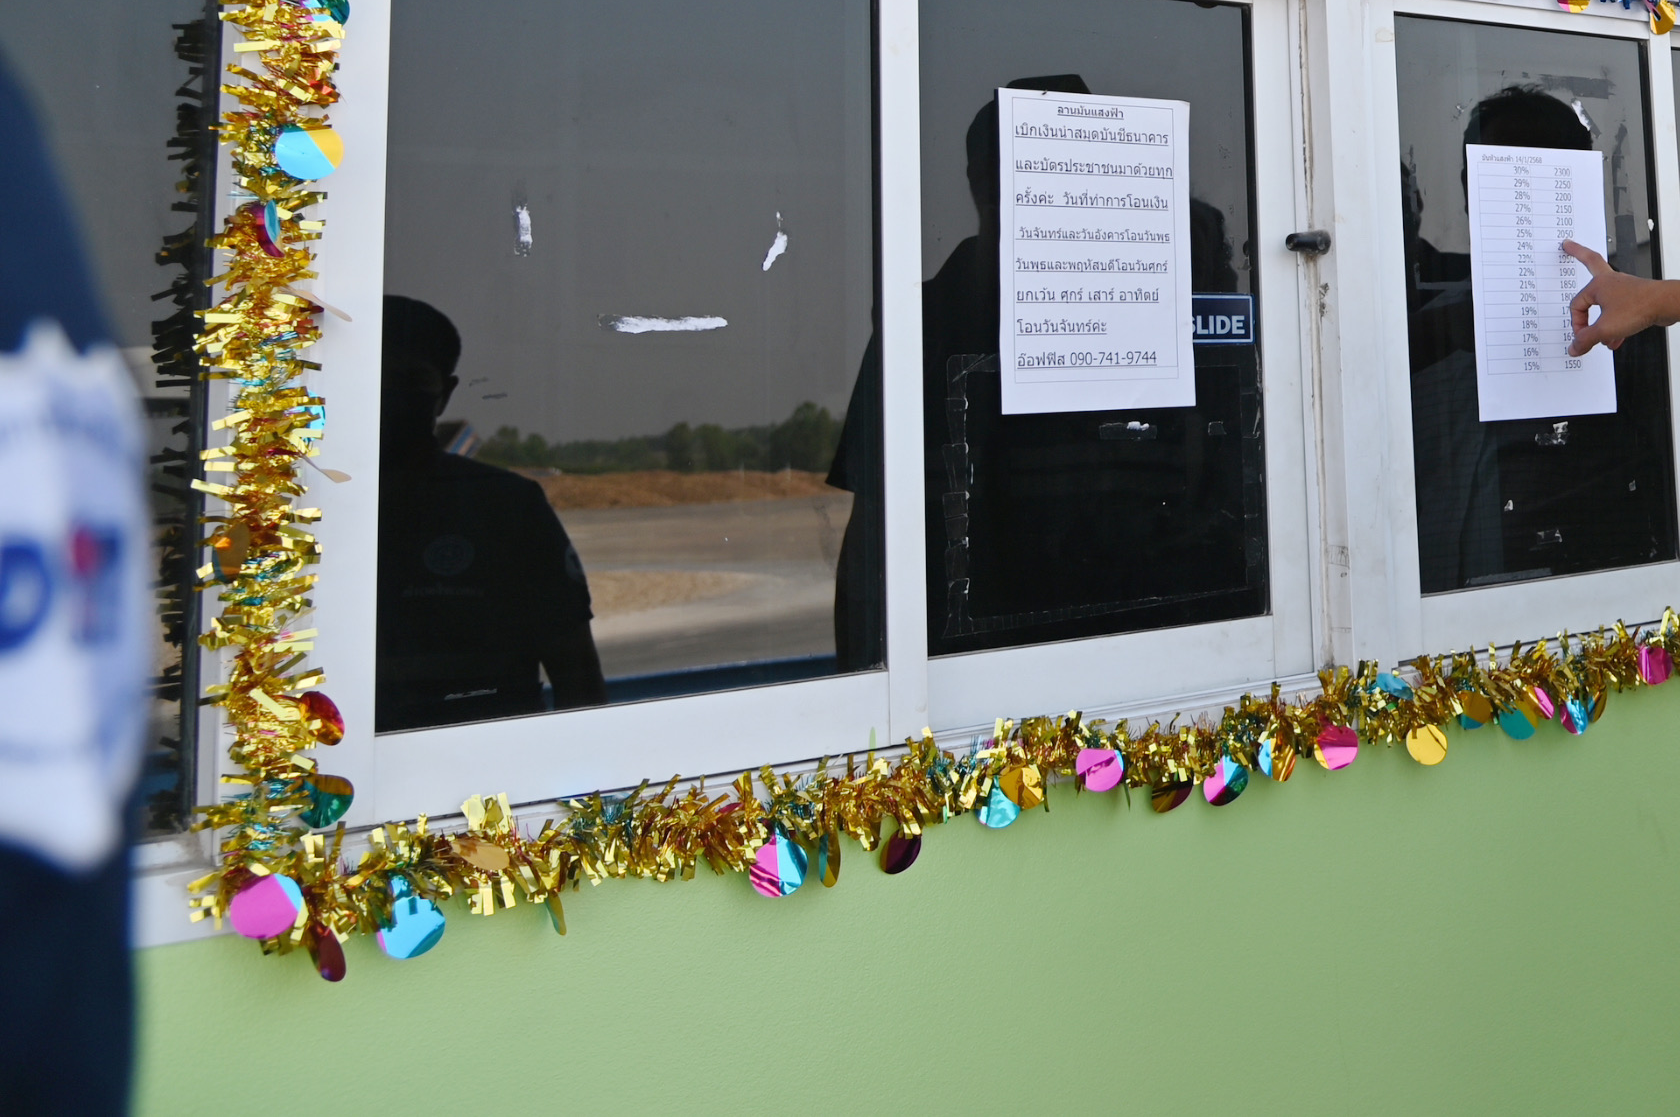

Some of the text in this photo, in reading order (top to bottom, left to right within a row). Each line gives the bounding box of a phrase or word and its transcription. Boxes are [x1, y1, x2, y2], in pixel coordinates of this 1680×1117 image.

[1513, 166, 1571, 177] 30% 2300
[1514, 178, 1572, 189] 29% 2250
[1015, 186, 1054, 205] ครั้งค่ะ
[1514, 191, 1572, 202] 28% 2200
[1515, 203, 1573, 214] 27% 2150
[1516, 216, 1573, 226] 26% 2100
[1516, 228, 1574, 239] 25% 2050
[1517, 241, 1533, 251] 24%
[1519, 267, 1576, 277] 22% 1900
[1519, 280, 1577, 289] 21% 1850
[1060, 287, 1083, 303] ศุกร์
[1088, 287, 1115, 302] เสาร์
[1520, 292, 1536, 302] 20%
[1521, 306, 1537, 316] 19%
[1522, 320, 1538, 329] 18%
[1523, 333, 1539, 343] 17%
[1523, 347, 1539, 357] 16%
[1070, 350, 1157, 366] 090-741-9744
[1524, 359, 1582, 371] 15% 1550
